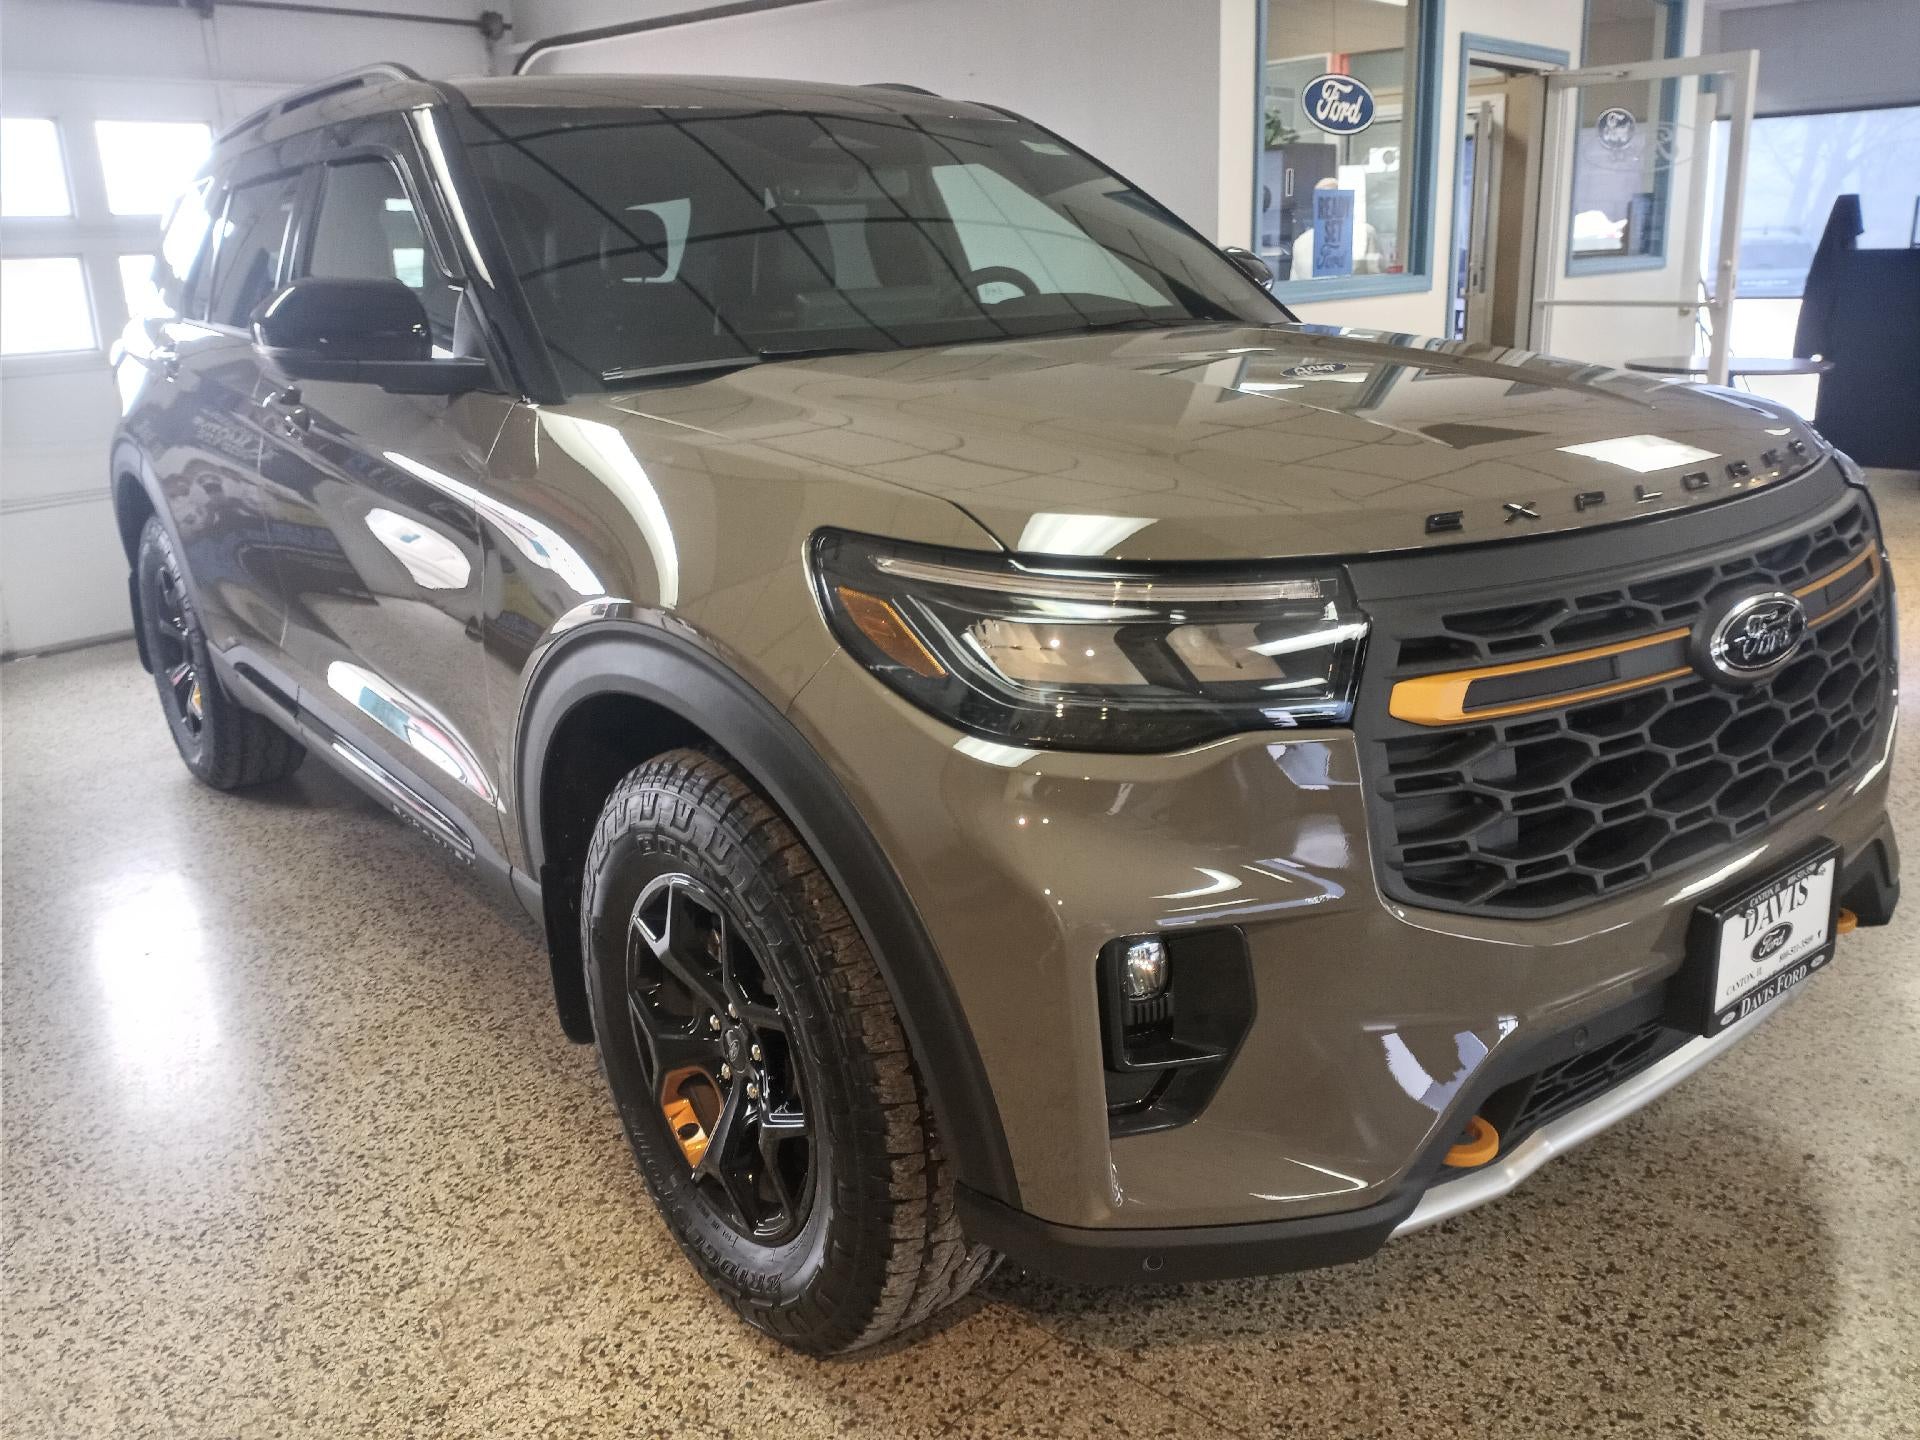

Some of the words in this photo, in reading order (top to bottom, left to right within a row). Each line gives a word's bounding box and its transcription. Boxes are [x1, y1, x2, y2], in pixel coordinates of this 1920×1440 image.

[1316, 80, 1364, 125] Ford
[1425, 439, 1806, 535] EXPLORER
[1743, 877, 1808, 940] DAVIS
[1758, 928, 1786, 957] Ford
[1740, 985, 1775, 1019] DAVIS
[1776, 964, 1807, 995] FORD
